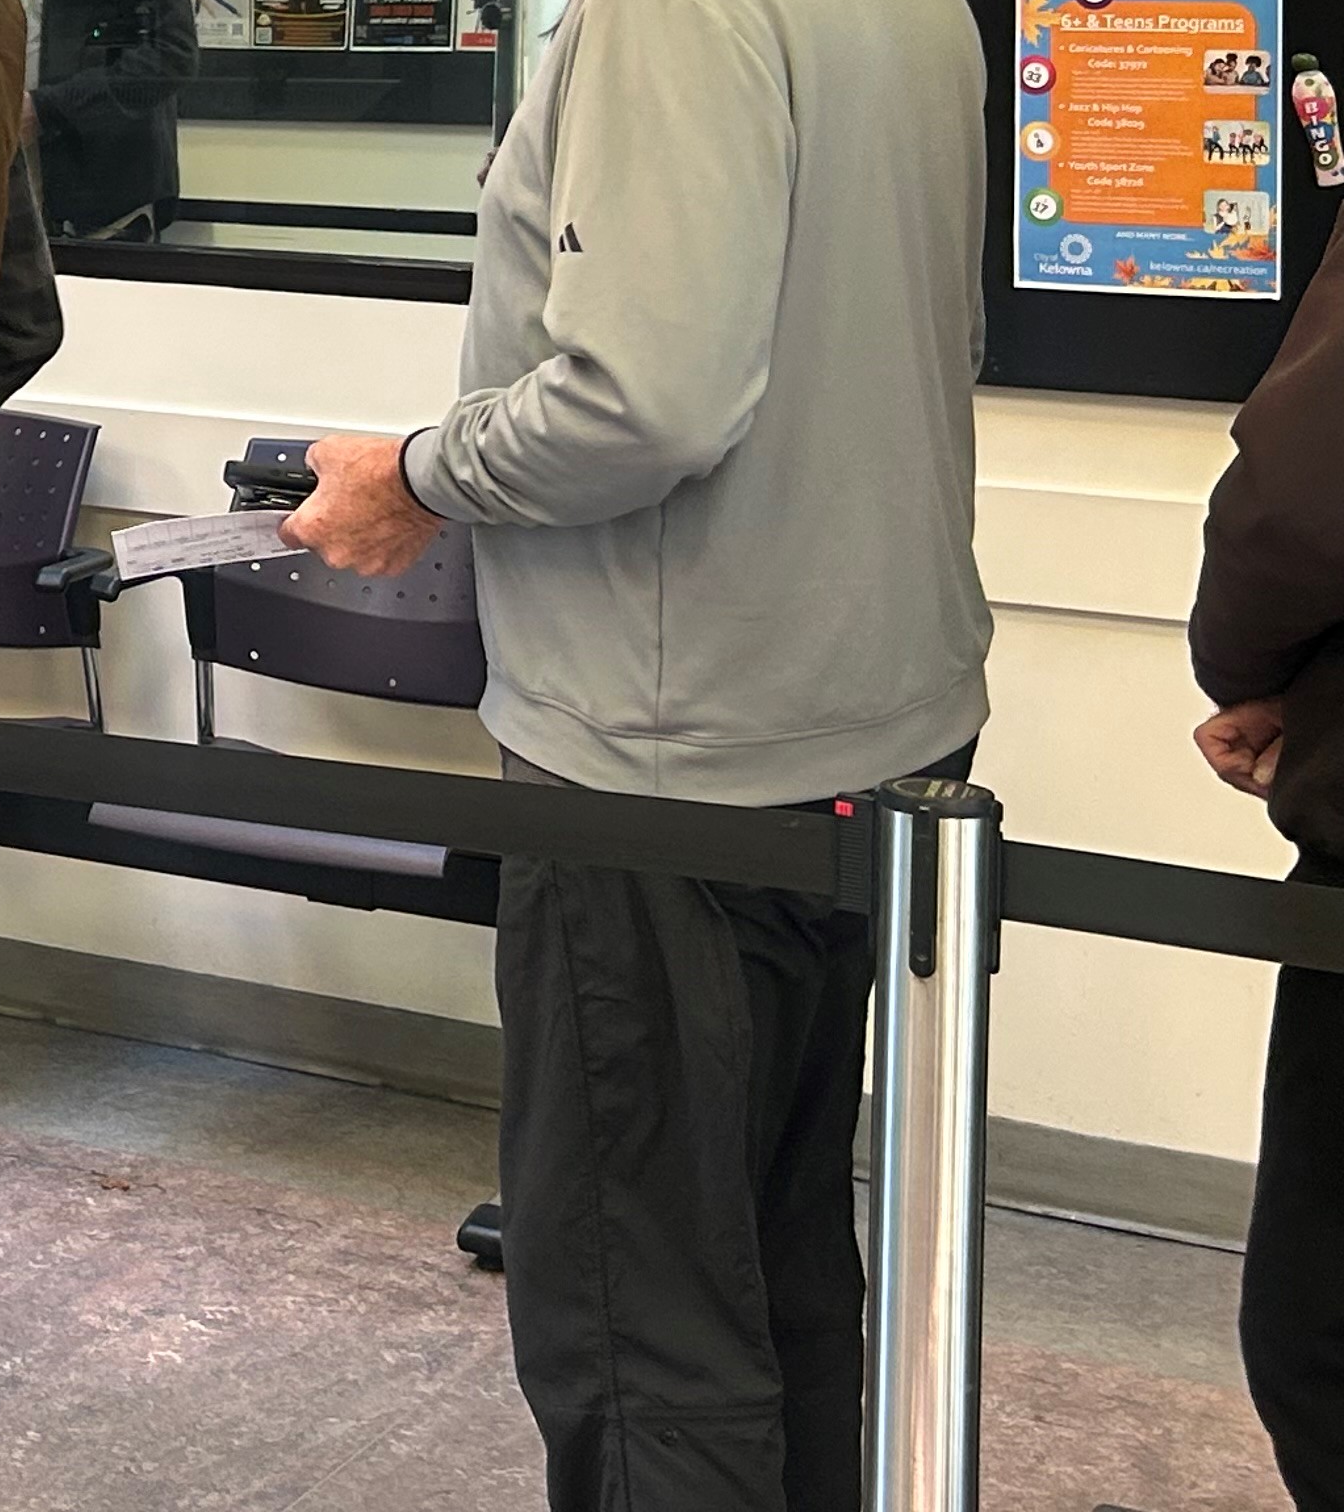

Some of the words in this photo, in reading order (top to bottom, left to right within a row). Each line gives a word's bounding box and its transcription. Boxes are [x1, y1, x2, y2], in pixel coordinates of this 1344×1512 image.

[1060, 14, 1082, 29] 6+
[1086, 14, 1100, 29] &
[1102, 14, 1153, 30] Teens
[1158, 15, 1245, 35] Programs
[1304, 101, 1333, 165] BINGO
[1032, 201, 1049, 214] 17
[1039, 263, 1093, 276] Kelowna
[1149, 260, 1268, 276] kelowna.ca/recreation
